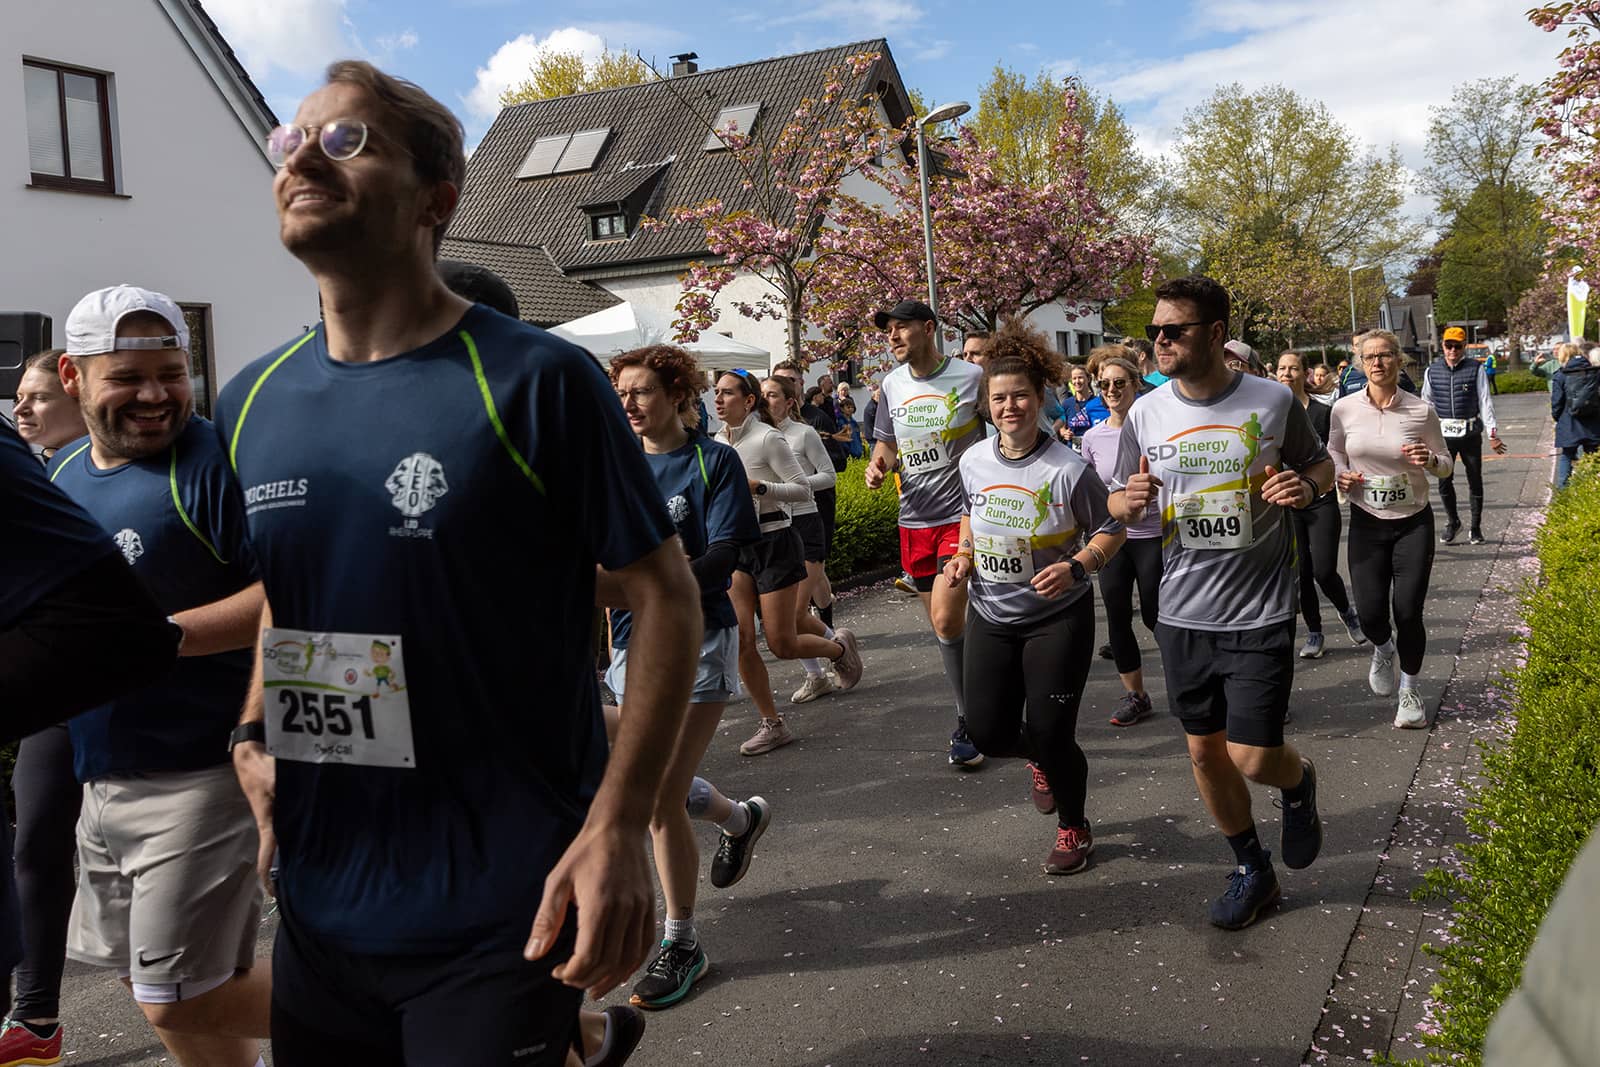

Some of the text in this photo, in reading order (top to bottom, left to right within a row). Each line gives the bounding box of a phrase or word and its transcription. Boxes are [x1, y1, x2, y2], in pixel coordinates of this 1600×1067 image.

[890, 404, 938, 418] SD Energy
[907, 415, 945, 428] Run 2026
[907, 448, 940, 467] 2840
[1147, 440, 1229, 462] SD Energy
[1179, 455, 1240, 475] Run 2026
[969, 493, 1025, 511] SD Energy
[1371, 488, 1406, 503] 1735
[985, 506, 1031, 530] Run 2026
[1186, 516, 1241, 538] 3049
[980, 553, 1023, 574] 3048
[279, 688, 376, 740] 2551
